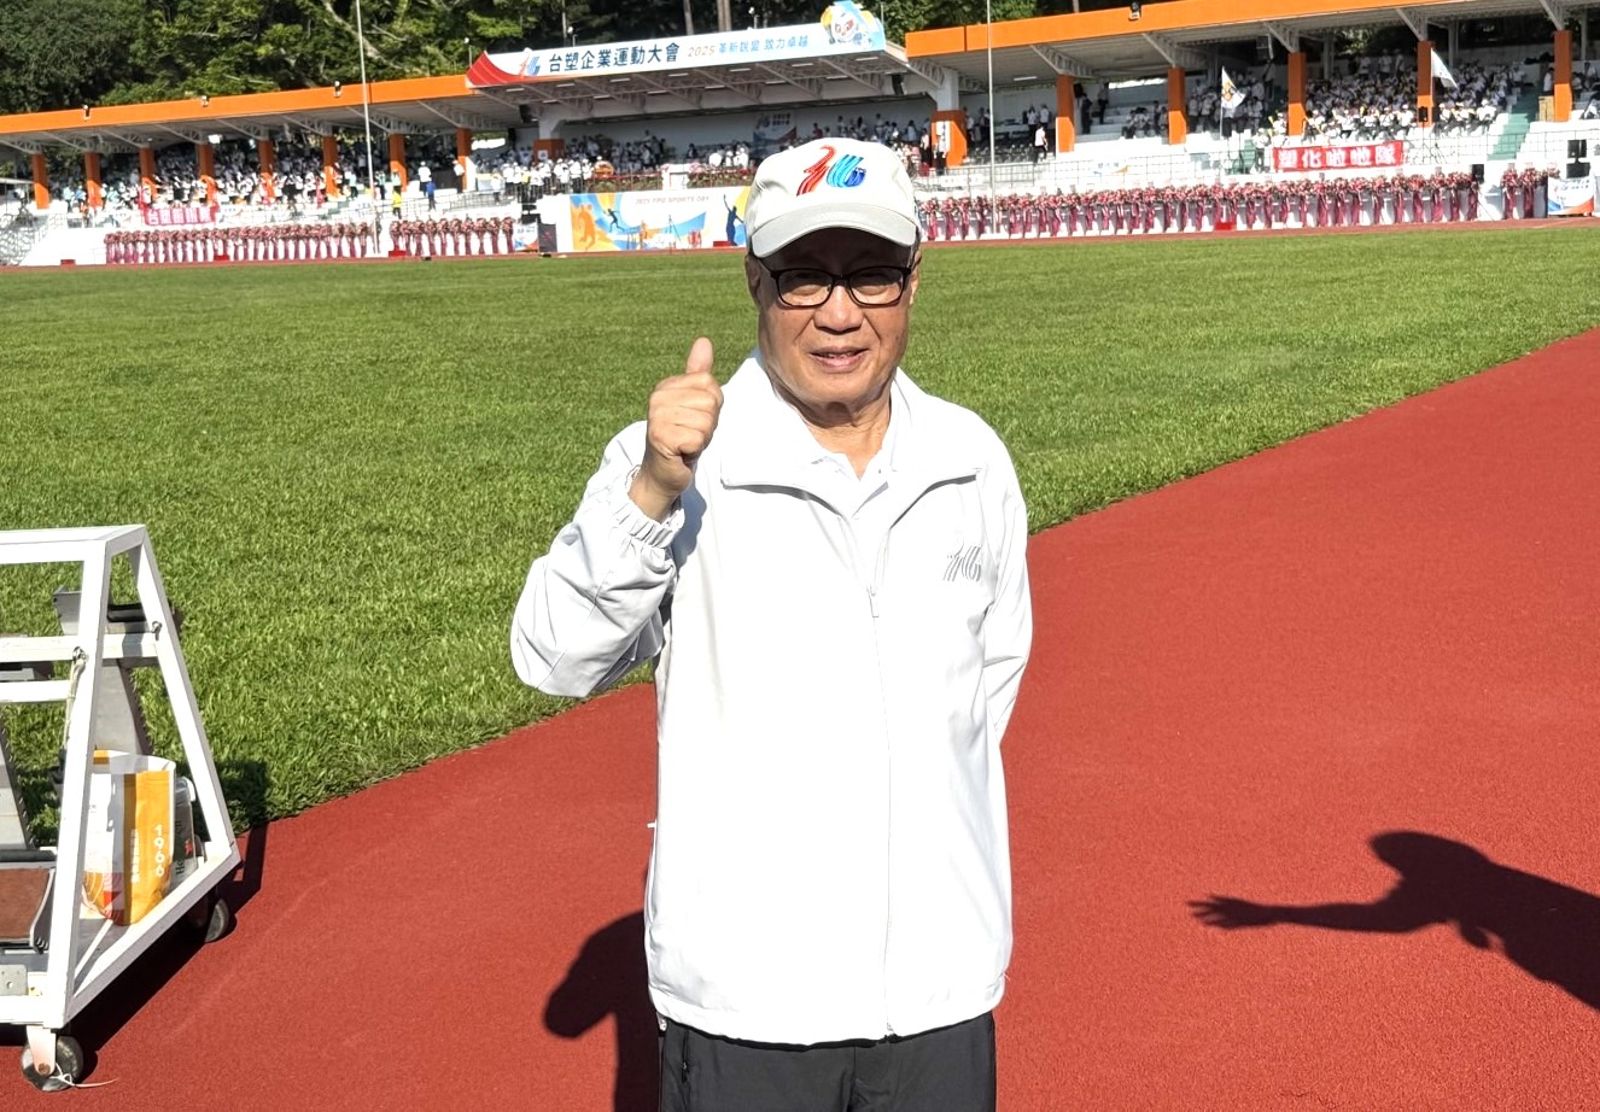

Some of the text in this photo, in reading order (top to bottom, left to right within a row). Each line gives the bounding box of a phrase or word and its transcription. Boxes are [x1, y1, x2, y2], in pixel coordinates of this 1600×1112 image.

[549, 42, 680, 72] 台塑企業運動大會
[688, 45, 715, 58] 2025
[1278, 143, 1396, 169] 塑化啦啦隊
